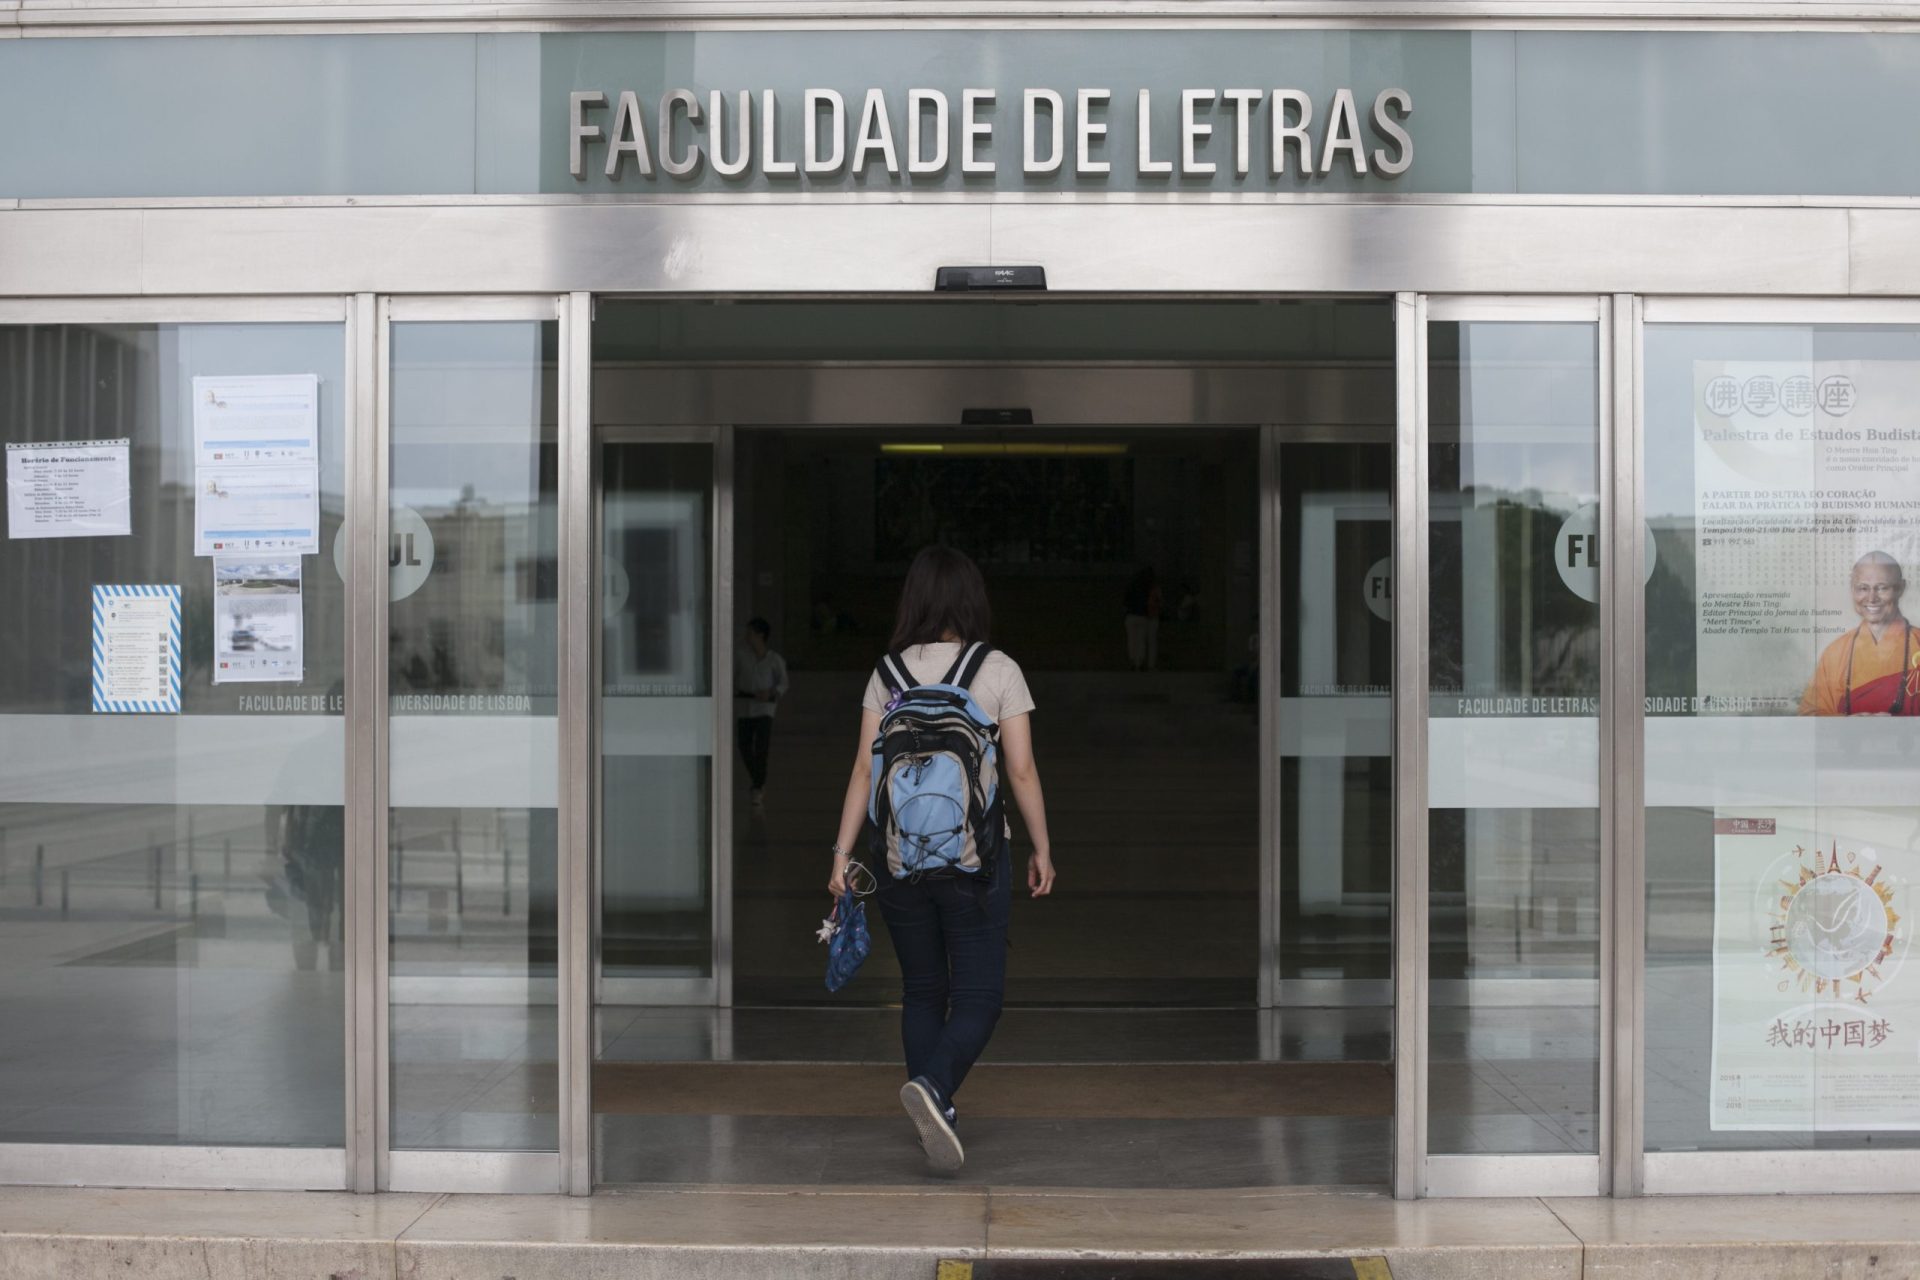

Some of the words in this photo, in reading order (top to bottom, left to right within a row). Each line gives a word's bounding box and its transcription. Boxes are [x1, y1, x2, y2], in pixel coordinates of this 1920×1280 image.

[569, 89, 997, 178] FACULDADE
[1022, 89, 1111, 175] DE
[1137, 89, 1414, 177] LETRAS
[1703, 429, 1769, 441] Palestra
[1775, 429, 1794, 441] de
[1800, 429, 1861, 441] Estudos
[1702, 490, 1710, 499] A
[1712, 490, 1751, 499] PARTIR
[1754, 490, 1769, 499] DO
[1772, 490, 1807, 499] SUTRA
[1810, 490, 1824, 499] DO
[1702, 501, 1737, 510] FALAR
[1739, 501, 1754, 510] DA
[1804, 501, 1819, 510] DO
[1821, 501, 1872, 510] BUDISMO
[239, 696, 308, 711] FACULDADE
[311, 696, 325, 711] DE
[469, 695, 485, 711] DE
[488, 695, 531, 711] LISBOA
[1458, 698, 1528, 714] FACULDADE
[1532, 698, 1548, 714] DE
[1710, 697, 1752, 712] LISBOA
[1766, 1018, 1894, 1050] 我的中国梦
